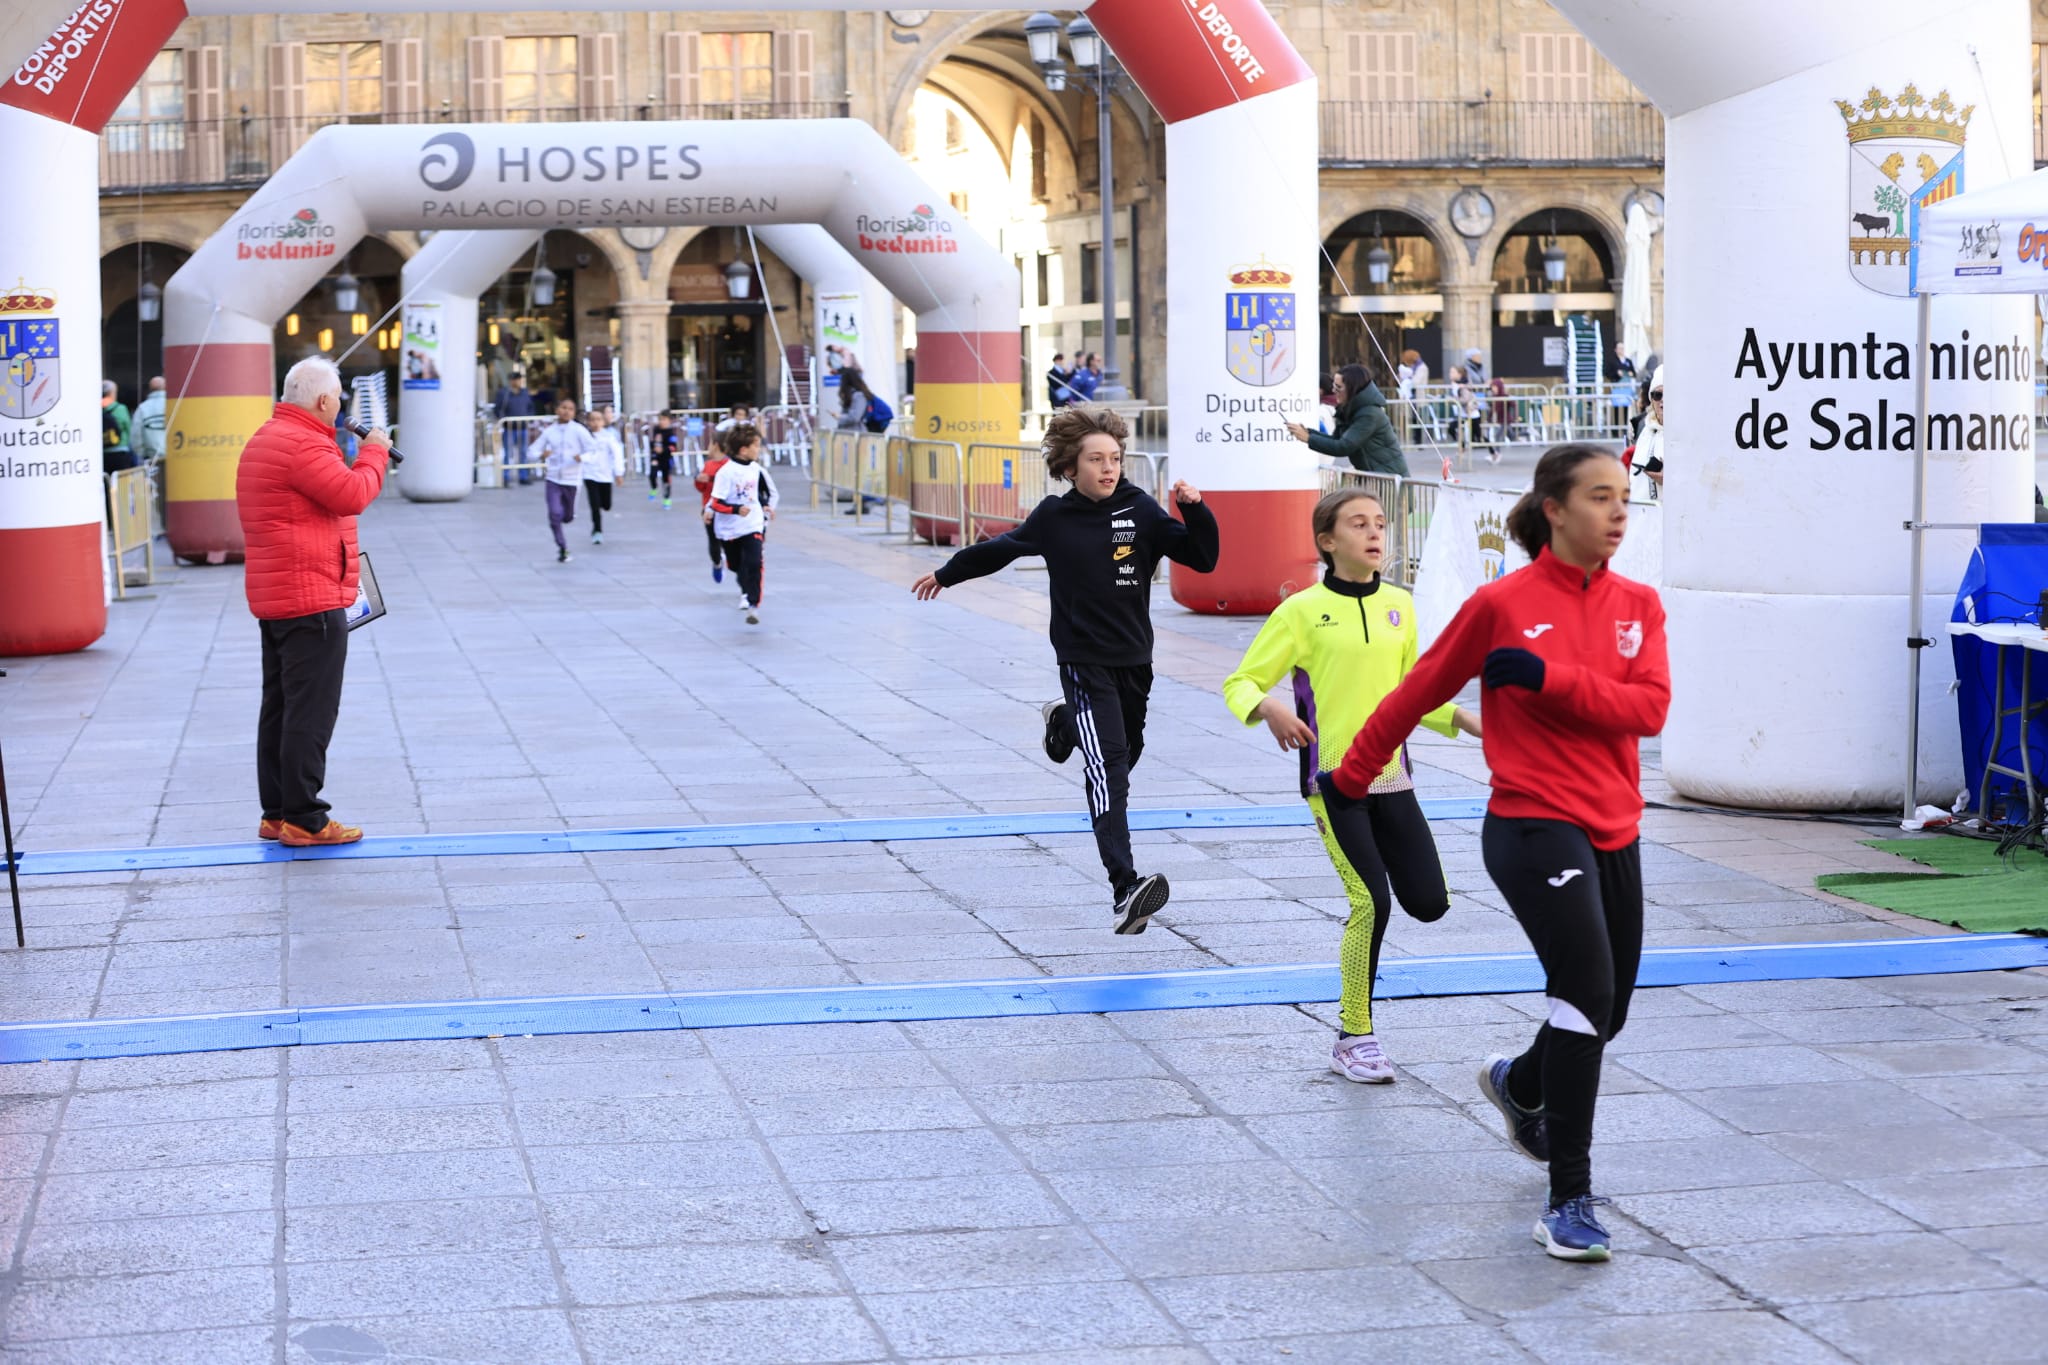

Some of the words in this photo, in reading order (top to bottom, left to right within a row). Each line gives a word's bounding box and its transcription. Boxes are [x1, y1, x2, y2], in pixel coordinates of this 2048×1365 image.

[34, 0, 120, 95] DEPORTIS
[1198, 2, 1265, 83] DEPORTE
[14, 41, 57, 86] CON
[498, 144, 703, 183] HOSPES
[422, 199, 547, 218] PALACIO
[556, 198, 592, 216] DE
[600, 198, 654, 216] SAN
[665, 195, 777, 215] ESTEBAN
[2018, 222, 2048, 271] Or
[1734, 327, 2031, 391] Ayuntamiento
[1206, 393, 1312, 417] Diputación
[1735, 398, 1789, 450] de
[1810, 397, 2030, 451] Salamanca
[0, 422, 83, 447] utación
[945, 420, 1002, 433] HOSPES
[1195, 427, 1212, 442] de
[1221, 422, 1296, 443] Salama
[1112, 531, 1136, 543] NIKE
